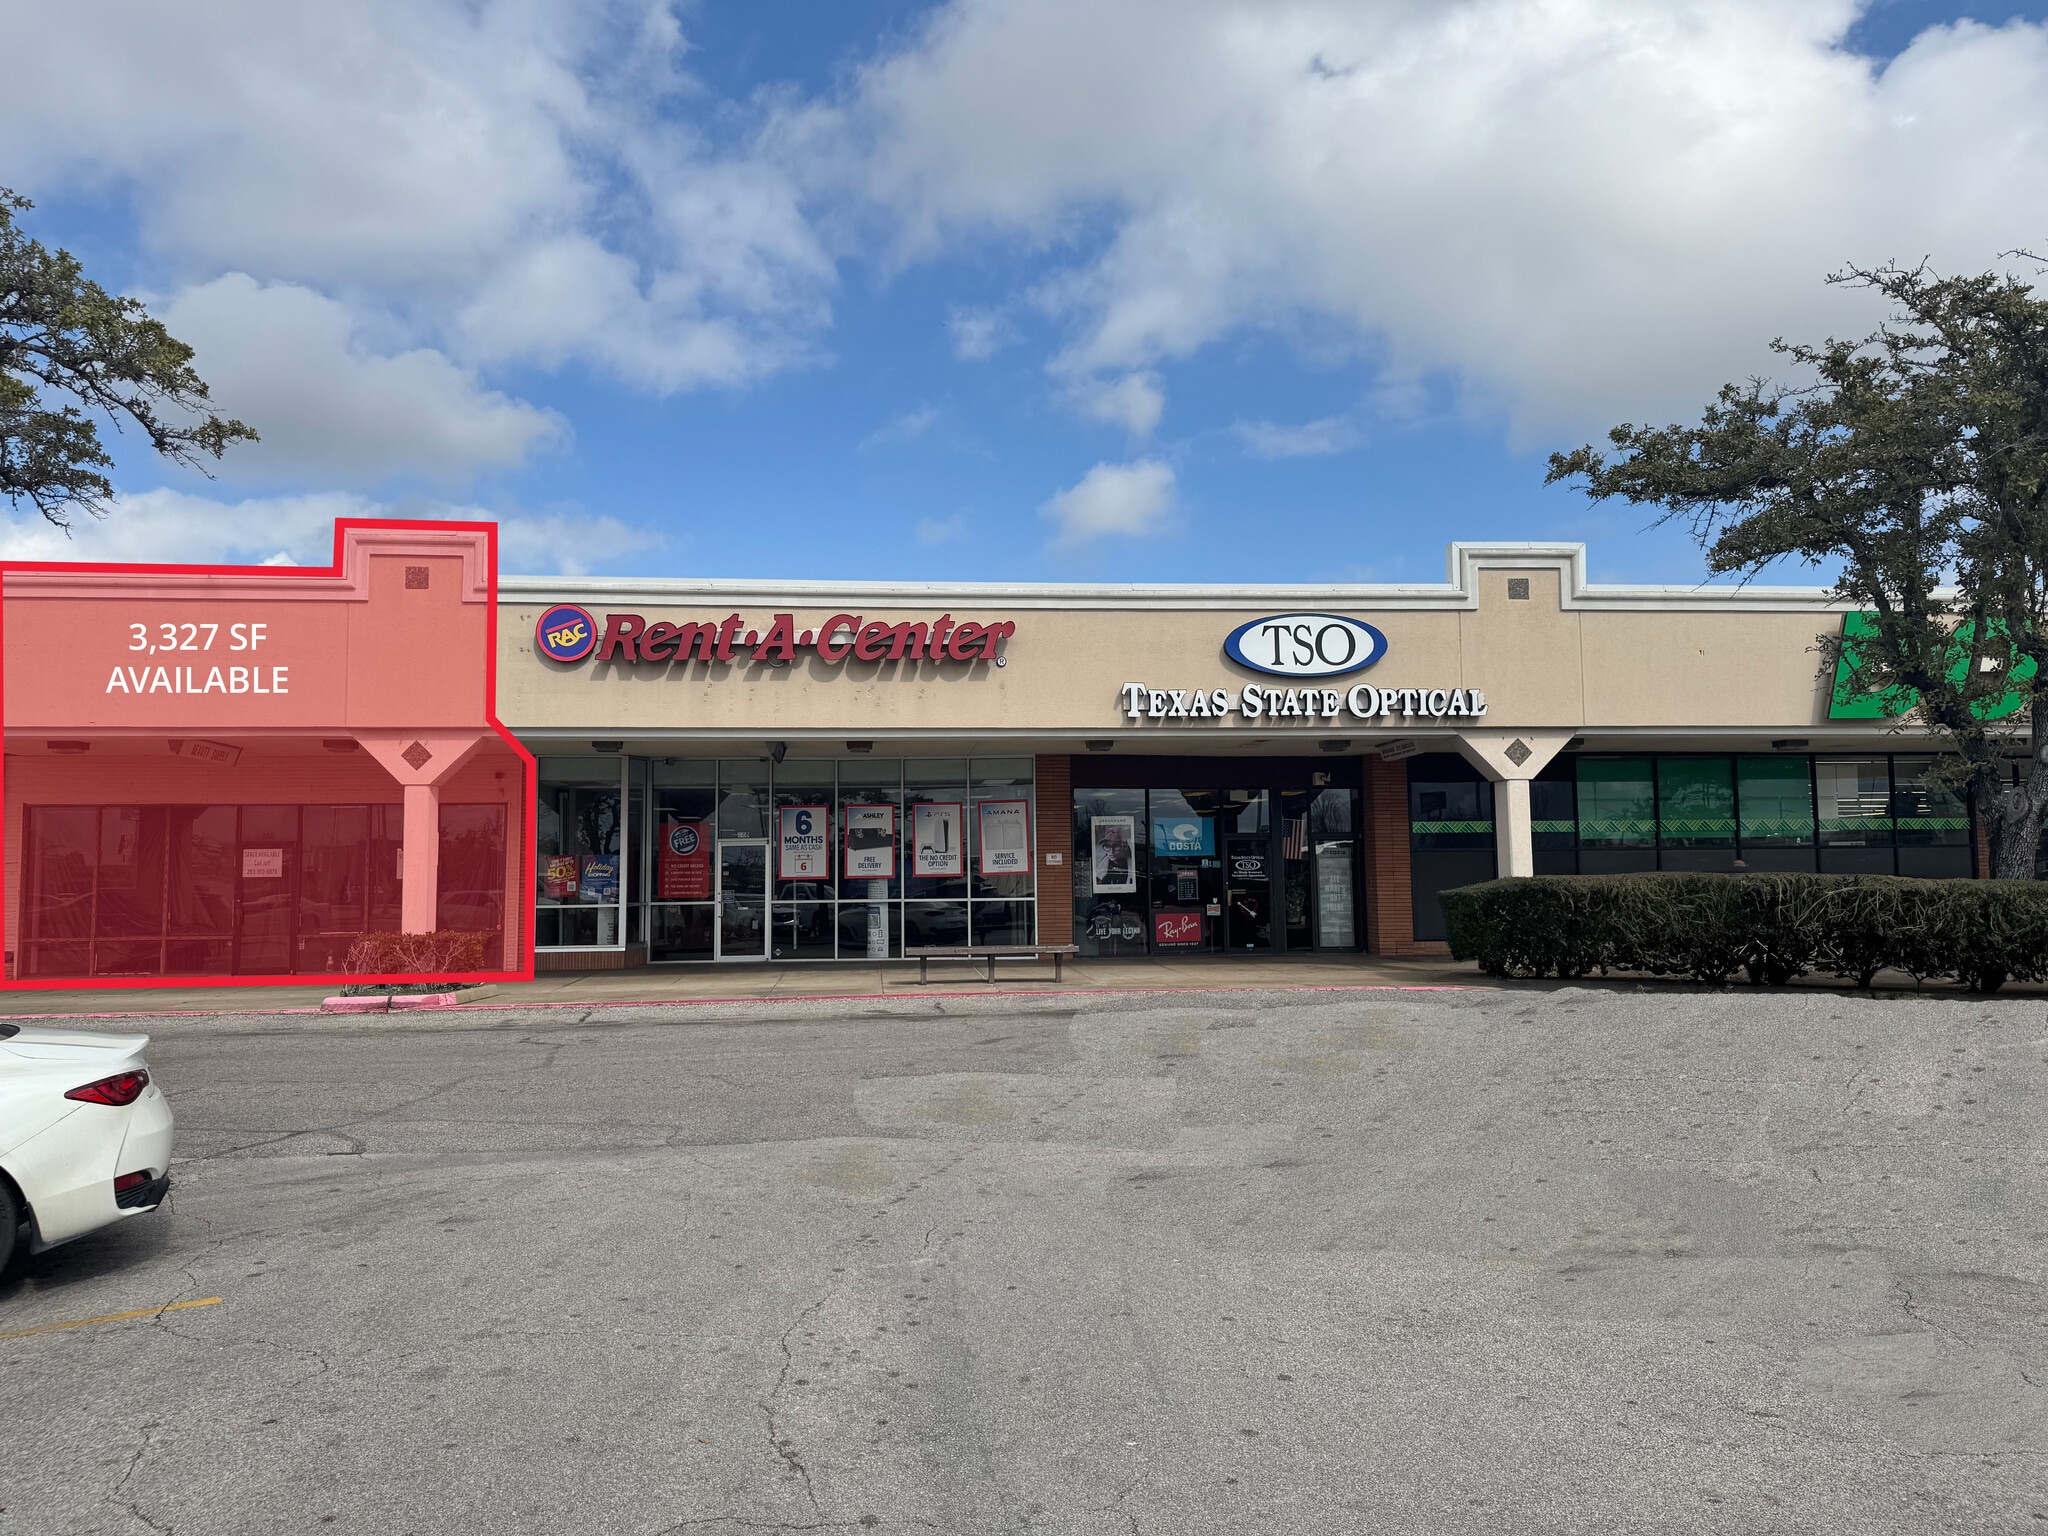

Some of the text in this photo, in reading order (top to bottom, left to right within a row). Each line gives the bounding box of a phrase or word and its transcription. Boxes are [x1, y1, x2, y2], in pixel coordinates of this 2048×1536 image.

[547, 623, 588, 650] RAC
[1261, 624, 1356, 666] TSO
[1122, 682, 1489, 718] TEXAS STATE OPTICAL
[795, 810, 812, 835] 6
[673, 833, 696, 848] FREE
[784, 836, 823, 844] MONTHS
[1169, 842, 1202, 851] COSTA
[585, 861, 614, 875] Holiday
[800, 862, 807, 871] 6
[992, 858, 1018, 866] INCLUDED
[1240, 861, 1256, 869] TSO
[1096, 928, 1107, 936] LIVE
[1122, 926, 1141, 935] LEGEND
